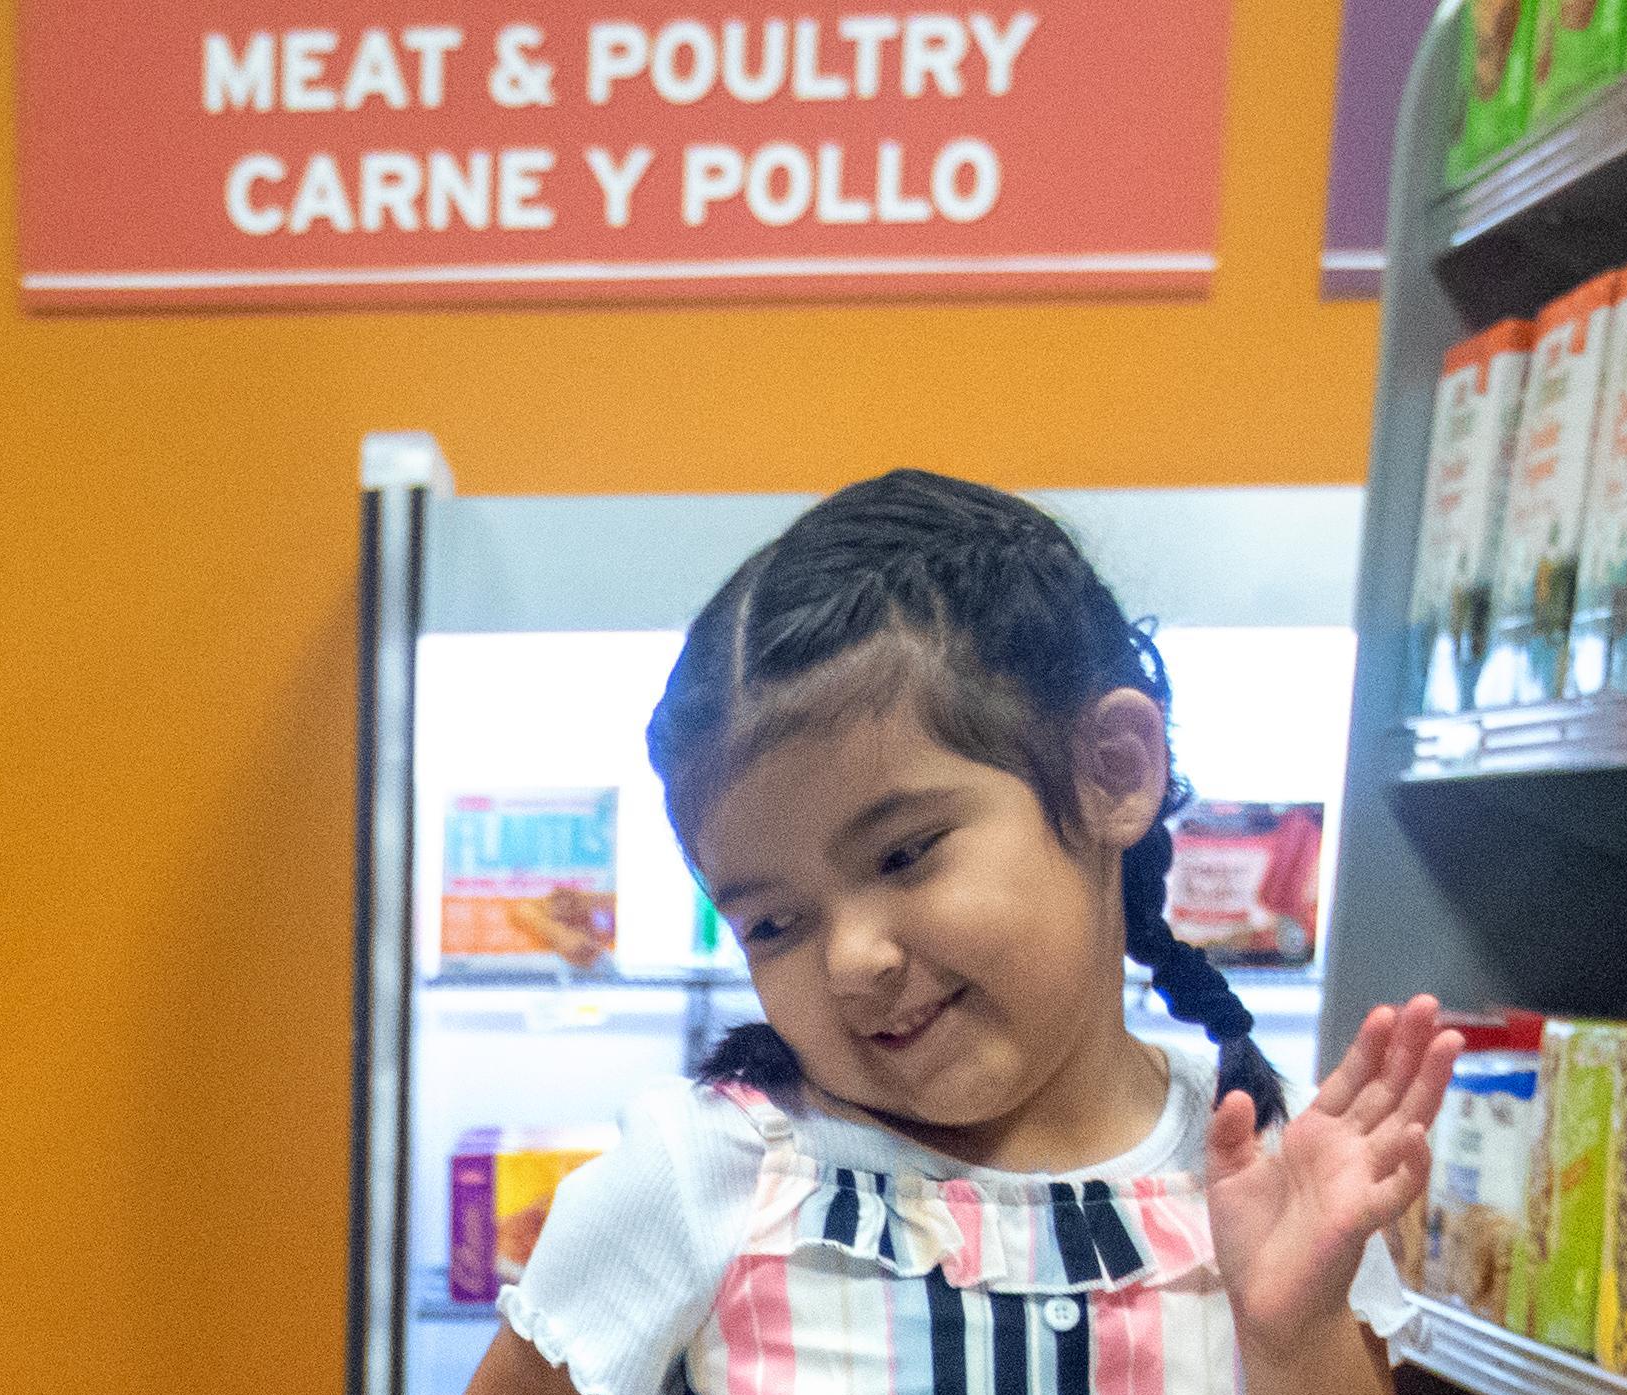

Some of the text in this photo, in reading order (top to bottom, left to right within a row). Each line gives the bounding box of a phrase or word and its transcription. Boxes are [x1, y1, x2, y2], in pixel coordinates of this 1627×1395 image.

[202, 11, 1039, 114] MEAT & POULTRY
[225, 139, 1000, 236] CARNE Y POLLO
